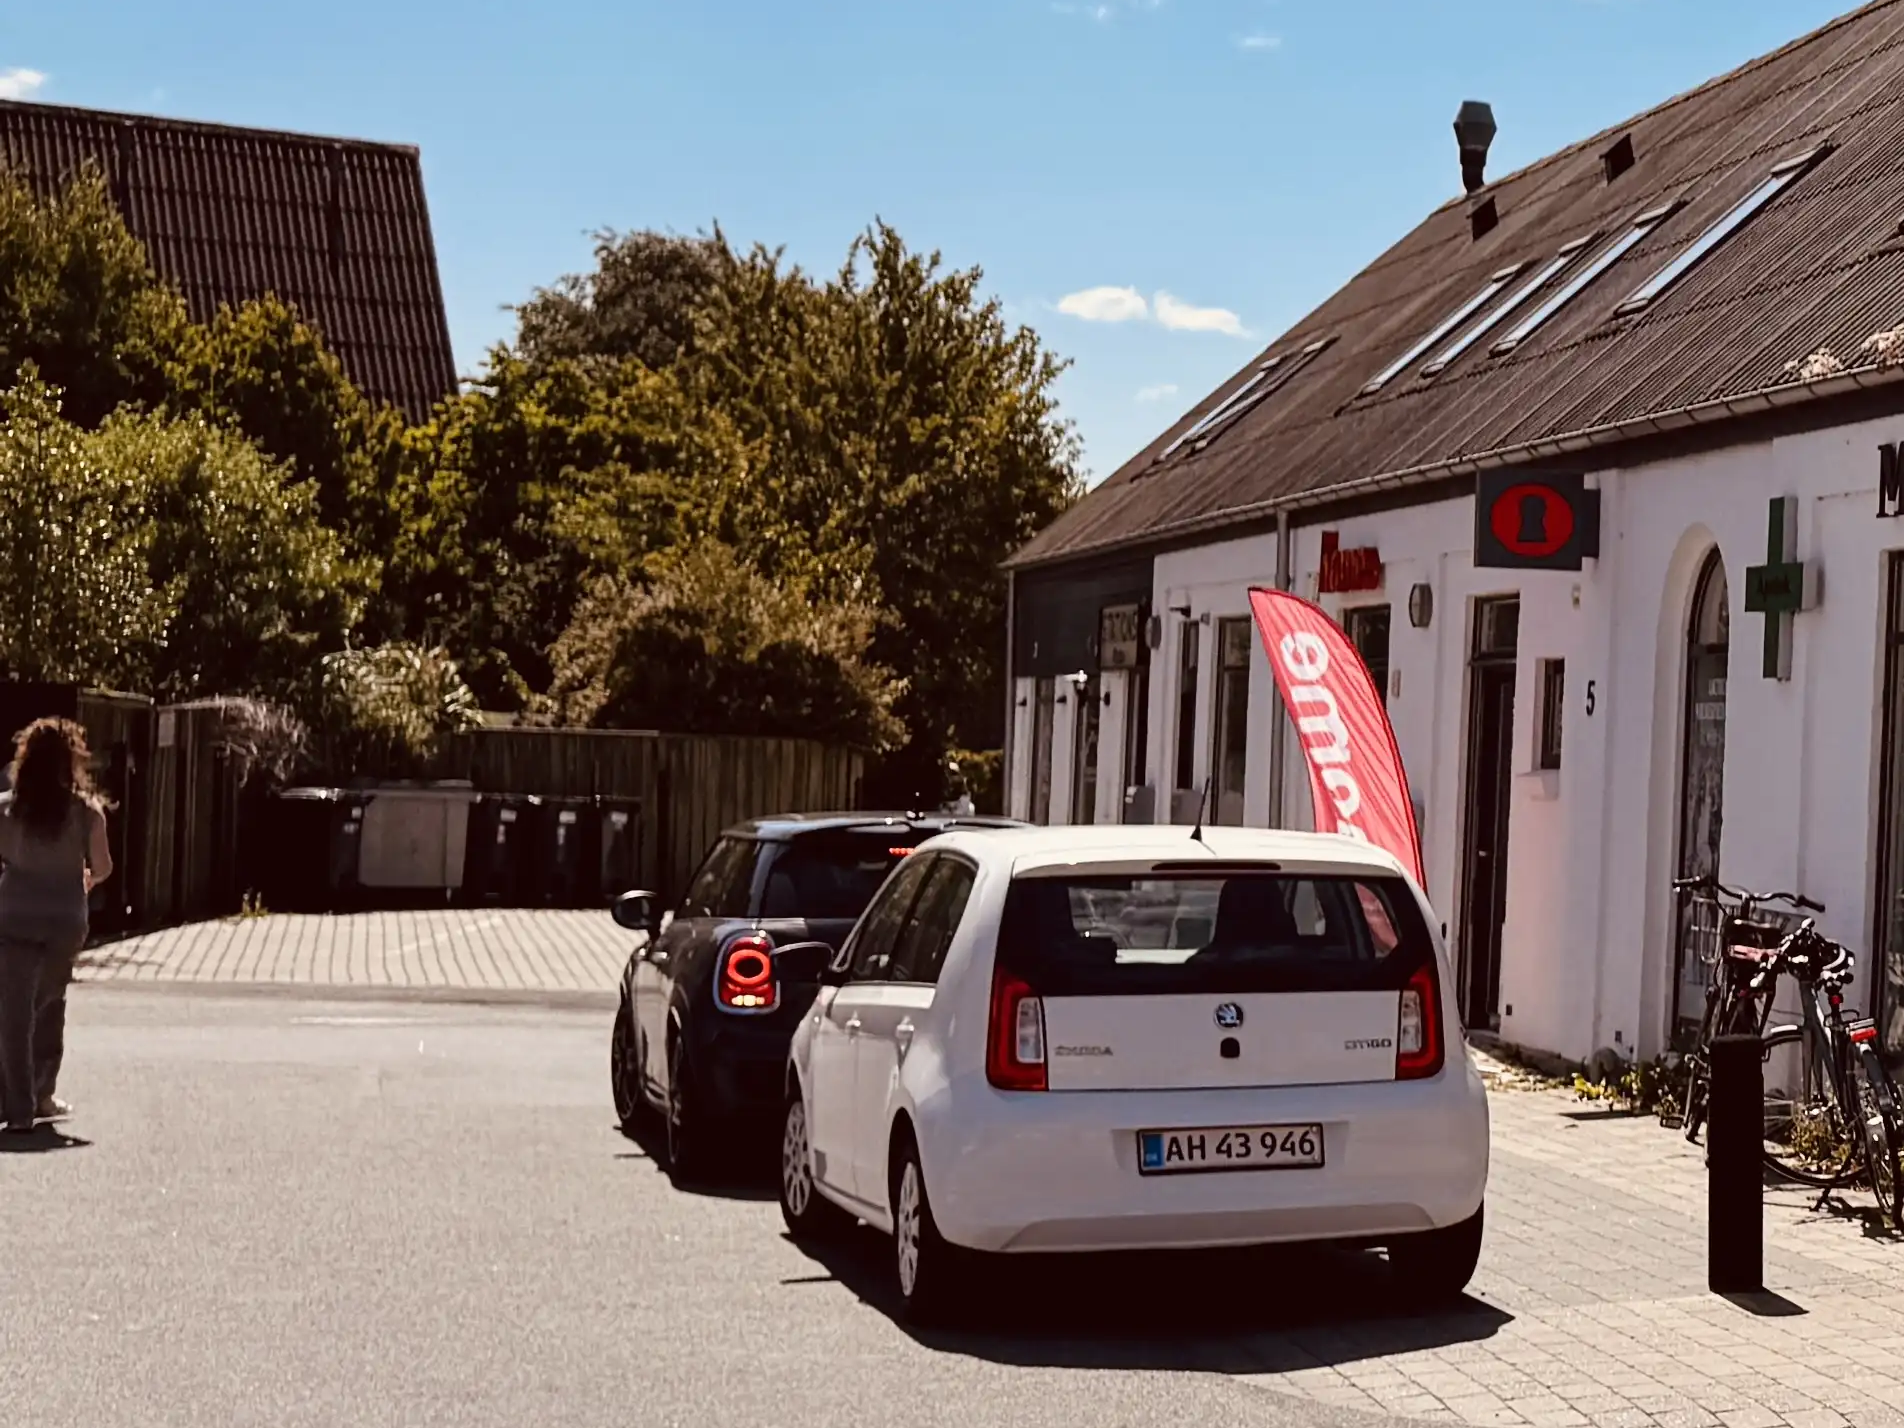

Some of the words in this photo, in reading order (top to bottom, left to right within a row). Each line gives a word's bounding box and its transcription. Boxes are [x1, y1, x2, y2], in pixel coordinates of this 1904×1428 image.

[1586, 680, 1596, 717] 5
[1166, 1134, 1206, 1162] AH
[1215, 1132, 1252, 1159] 43
[1259, 1130, 1315, 1159] 946
